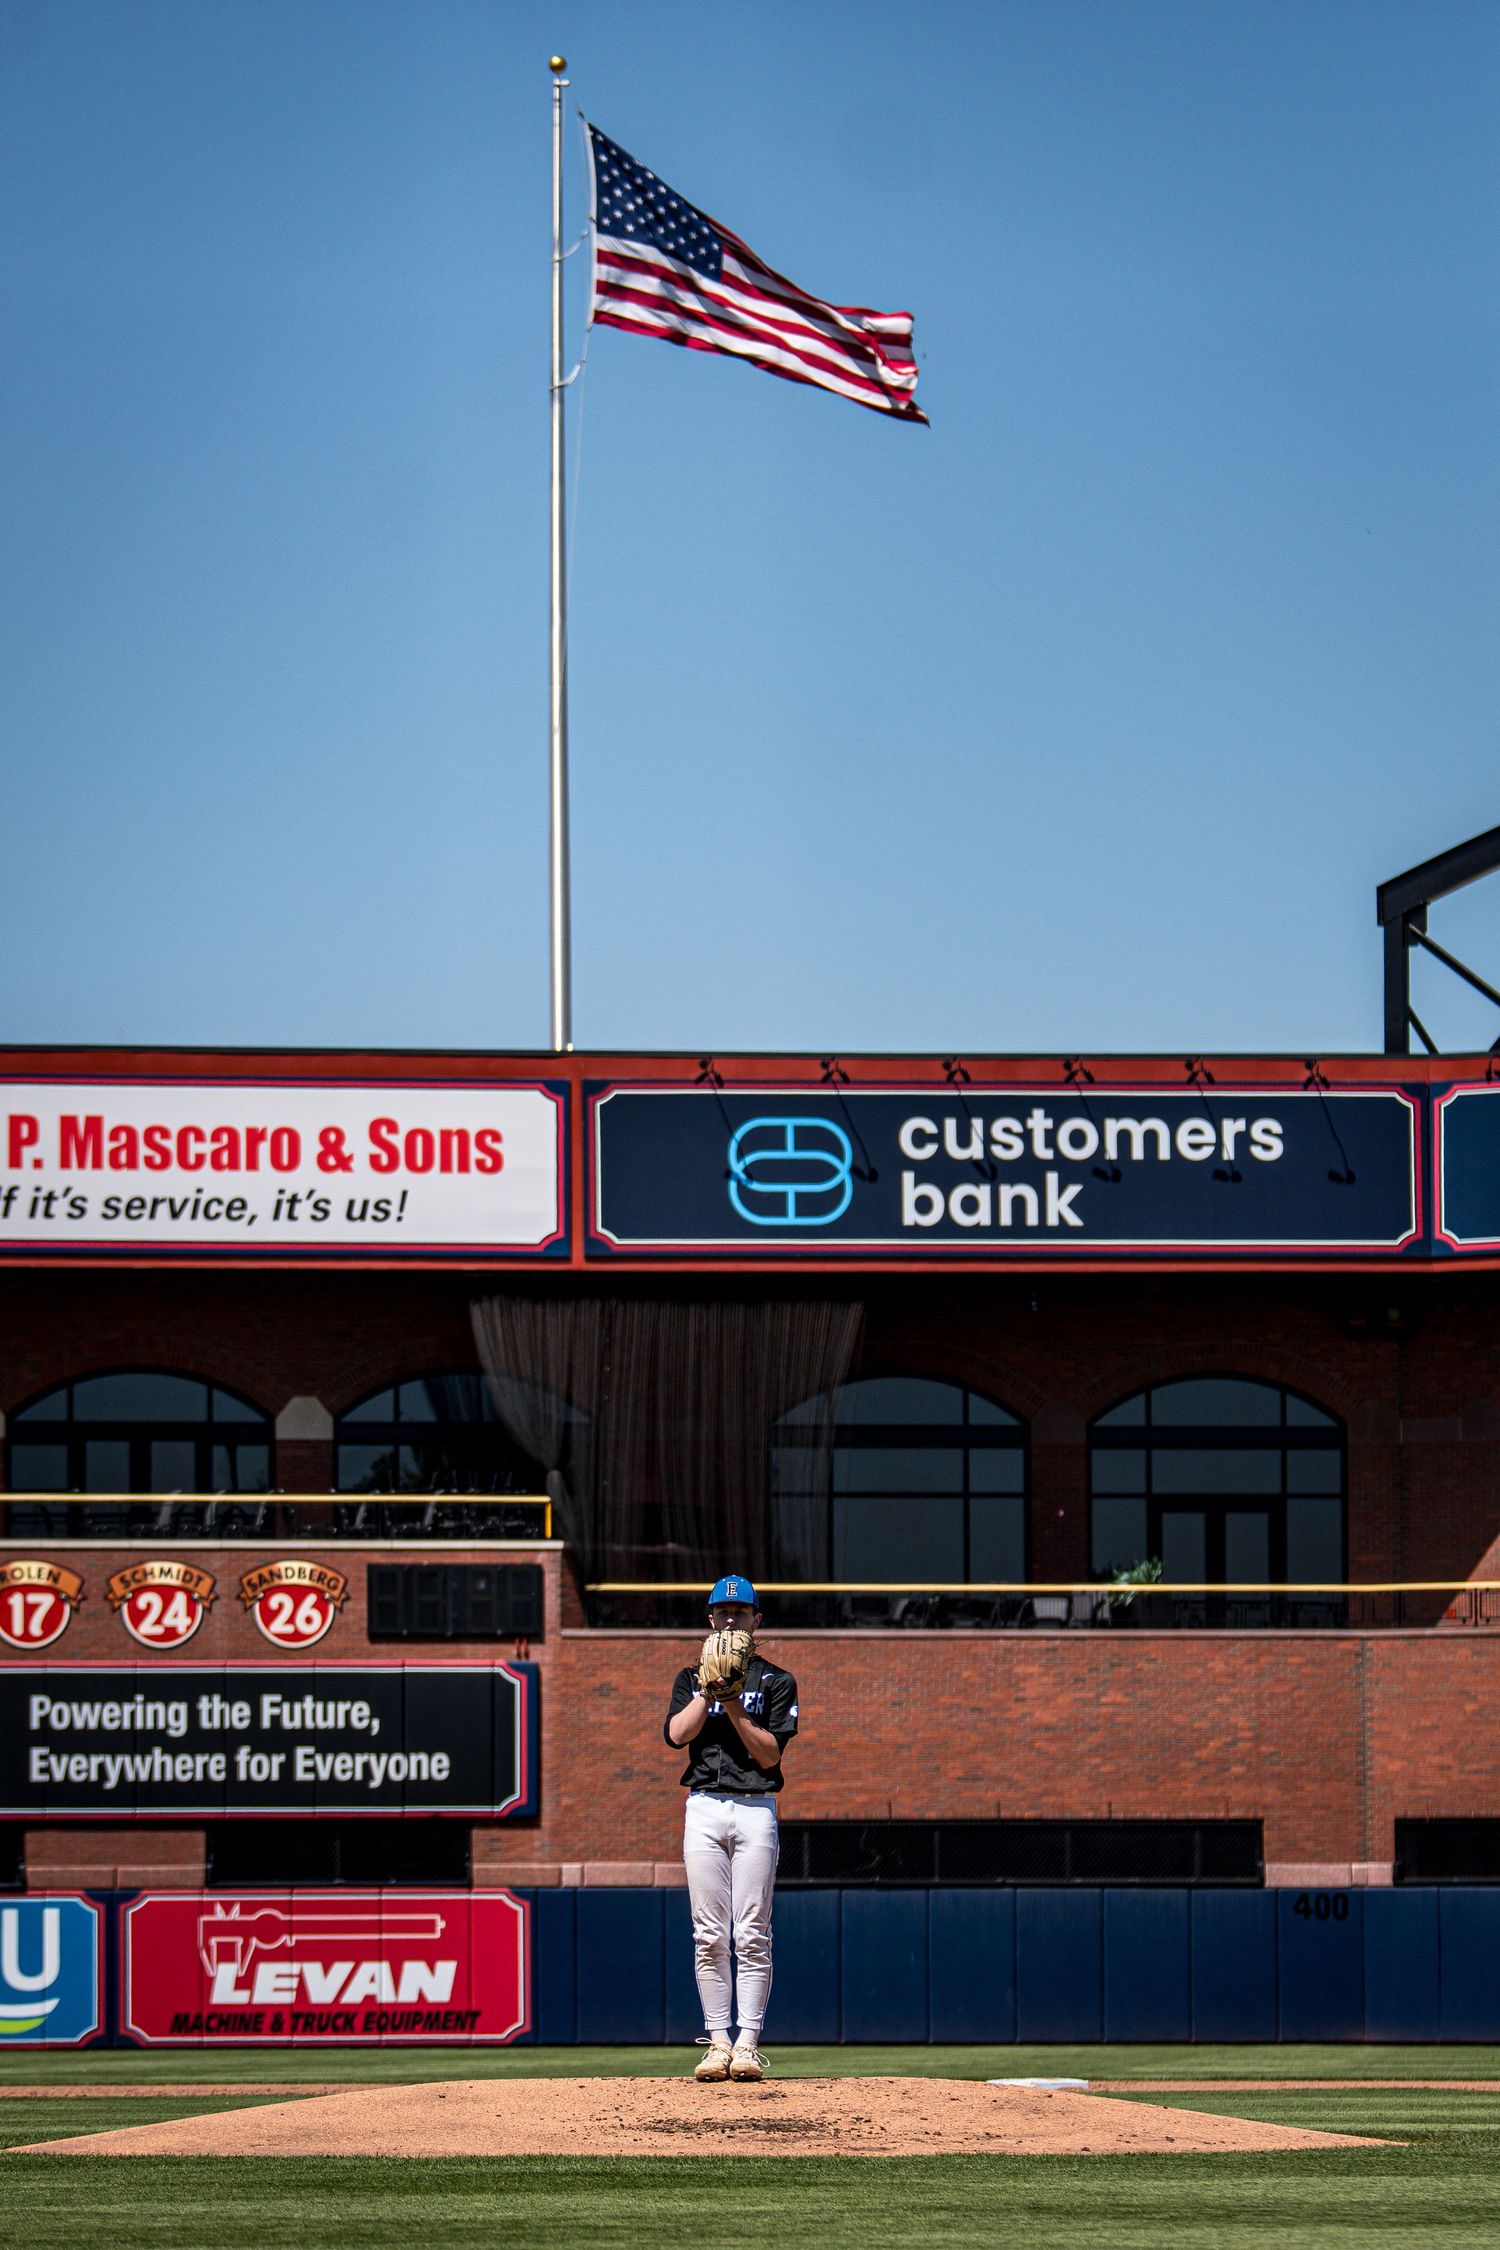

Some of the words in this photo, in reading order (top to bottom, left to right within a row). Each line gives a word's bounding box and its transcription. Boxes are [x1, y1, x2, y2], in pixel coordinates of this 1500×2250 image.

[7, 1114, 43, 1170] P.
[59, 1114, 301, 1173] Mascaro
[315, 1125, 354, 1174] &
[367, 1116, 505, 1175] Sons
[899, 1108, 1284, 1161] customers
[28, 1186, 89, 1220] it’s
[101, 1188, 259, 1226] service,
[272, 1188, 331, 1222] it’s
[345, 1189, 408, 1223] us!
[902, 1170, 1085, 1227] bank
[119, 1566, 205, 1589] SCHMIDT
[246, 1566, 340, 1592] SANDBERG
[726, 1581, 738, 1597] E
[7, 1592, 56, 1637] 17
[136, 1591, 192, 1636] 24
[268, 1592, 323, 1635] 26
[29, 1694, 189, 1737] Powering
[198, 1694, 251, 1731] the
[260, 1694, 380, 1736] Future,
[29, 1746, 227, 1789] Everywhere
[235, 1745, 286, 1782] for
[294, 1746, 450, 1789] Everyone
[1293, 1893, 1349, 1921] 400
[210, 1960, 458, 2005] LEVAN
[170, 2012, 265, 2034] MACHINE
[270, 2012, 284, 2033] &
[290, 2012, 358, 2033] TRUCK
[363, 2010, 482, 2032] EQUIPMENT
